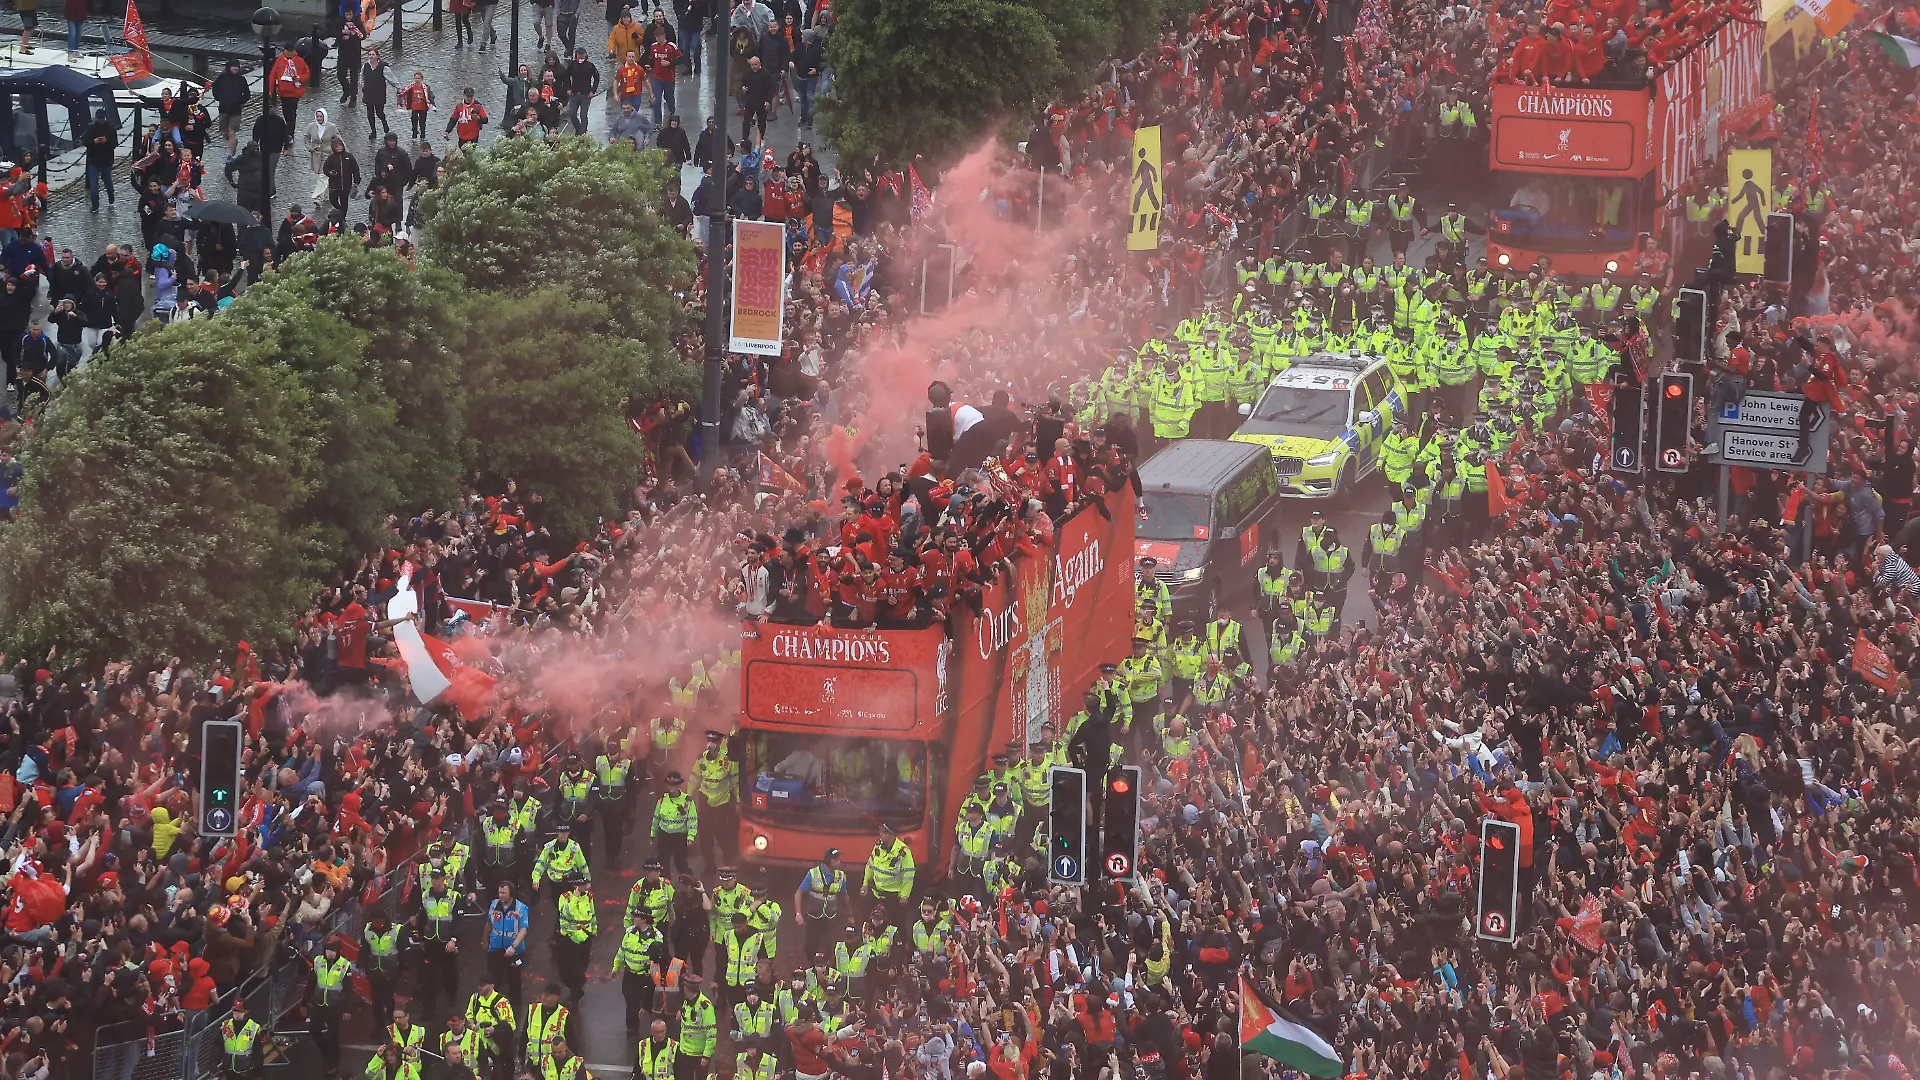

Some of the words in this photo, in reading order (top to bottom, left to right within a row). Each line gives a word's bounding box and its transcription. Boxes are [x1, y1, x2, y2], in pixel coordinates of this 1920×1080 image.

[1517, 94, 1613, 117] CHAMPIONS
[737, 308, 777, 317] BEDROCK
[1724, 402, 1737, 417] P
[1742, 400, 1766, 410] John
[1770, 401, 1799, 413] Lewis
[1741, 413, 1784, 424] Hanover
[1787, 416, 1800, 426] St
[1731, 436, 1775, 448] Hanover
[1778, 440, 1790, 449] St
[1728, 446, 1767, 458] Service
[1769, 451, 1792, 460] area
[1198, 528, 1205, 536] 7
[979, 601, 1023, 660] Ours.
[1051, 532, 1104, 608] Again.
[837, 633, 882, 641] LEAGUE
[772, 634, 890, 663] CHAMPIONS
[756, 796, 762, 805] 5
